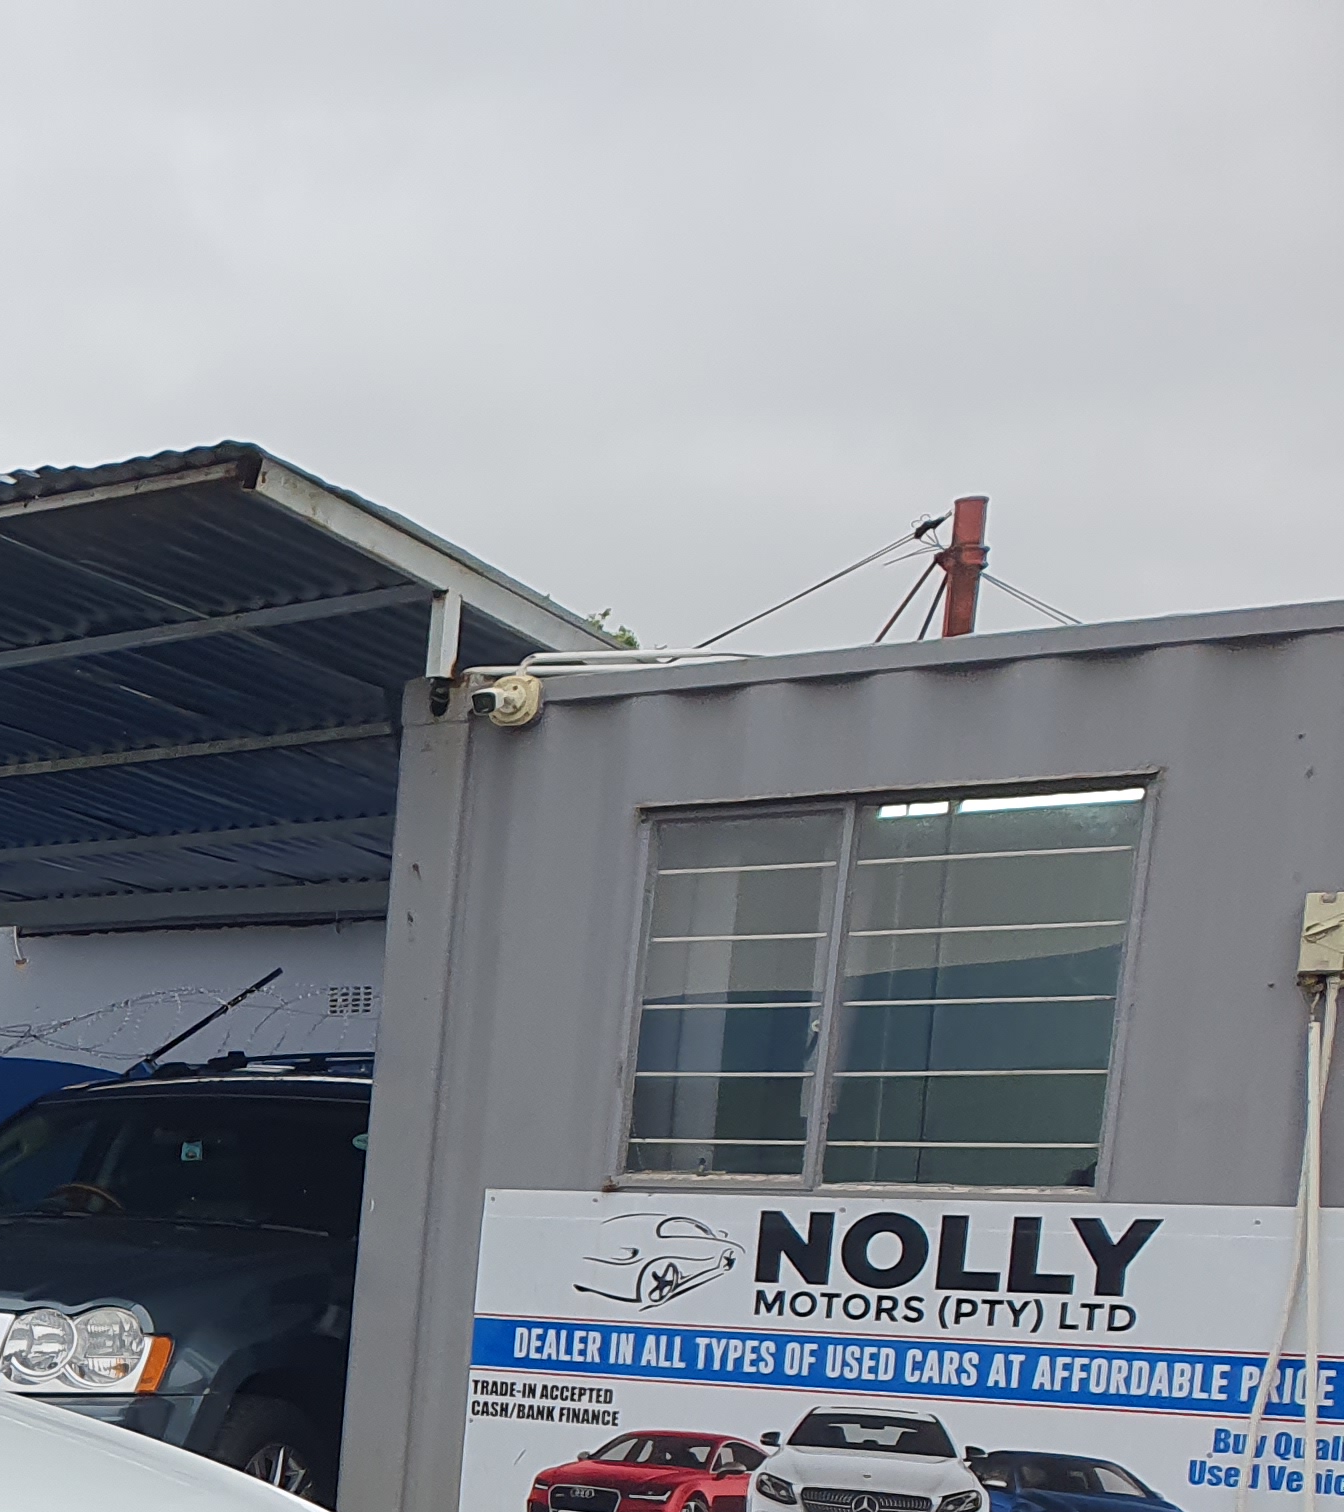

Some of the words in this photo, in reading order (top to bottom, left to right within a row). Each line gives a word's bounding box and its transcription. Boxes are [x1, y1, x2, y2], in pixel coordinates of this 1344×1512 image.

[754, 1210, 1165, 1297] NOLLY
[753, 1290, 925, 1324] MOTORS
[937, 1294, 1044, 1333] (PTY)
[1058, 1302, 1138, 1332] LTD
[513, 1327, 602, 1363] DEALER
[609, 1332, 635, 1365] IN
[640, 1334, 686, 1369] ALL
[695, 1337, 776, 1375] TYPES
[783, 1341, 819, 1377] OF
[825, 1344, 897, 1382] USED
[904, 1348, 980, 1387] CARS
[986, 1353, 1026, 1389] AT
[1031, 1355, 1231, 1401] AFFORDABLE
[471, 1379, 537, 1399] TRADE-IN
[539, 1383, 614, 1404] ACCEPTED
[470, 1401, 555, 1423] CASH/BANK
[558, 1407, 619, 1427] FINANCE
[1274, 1431, 1344, 1461] Qual
